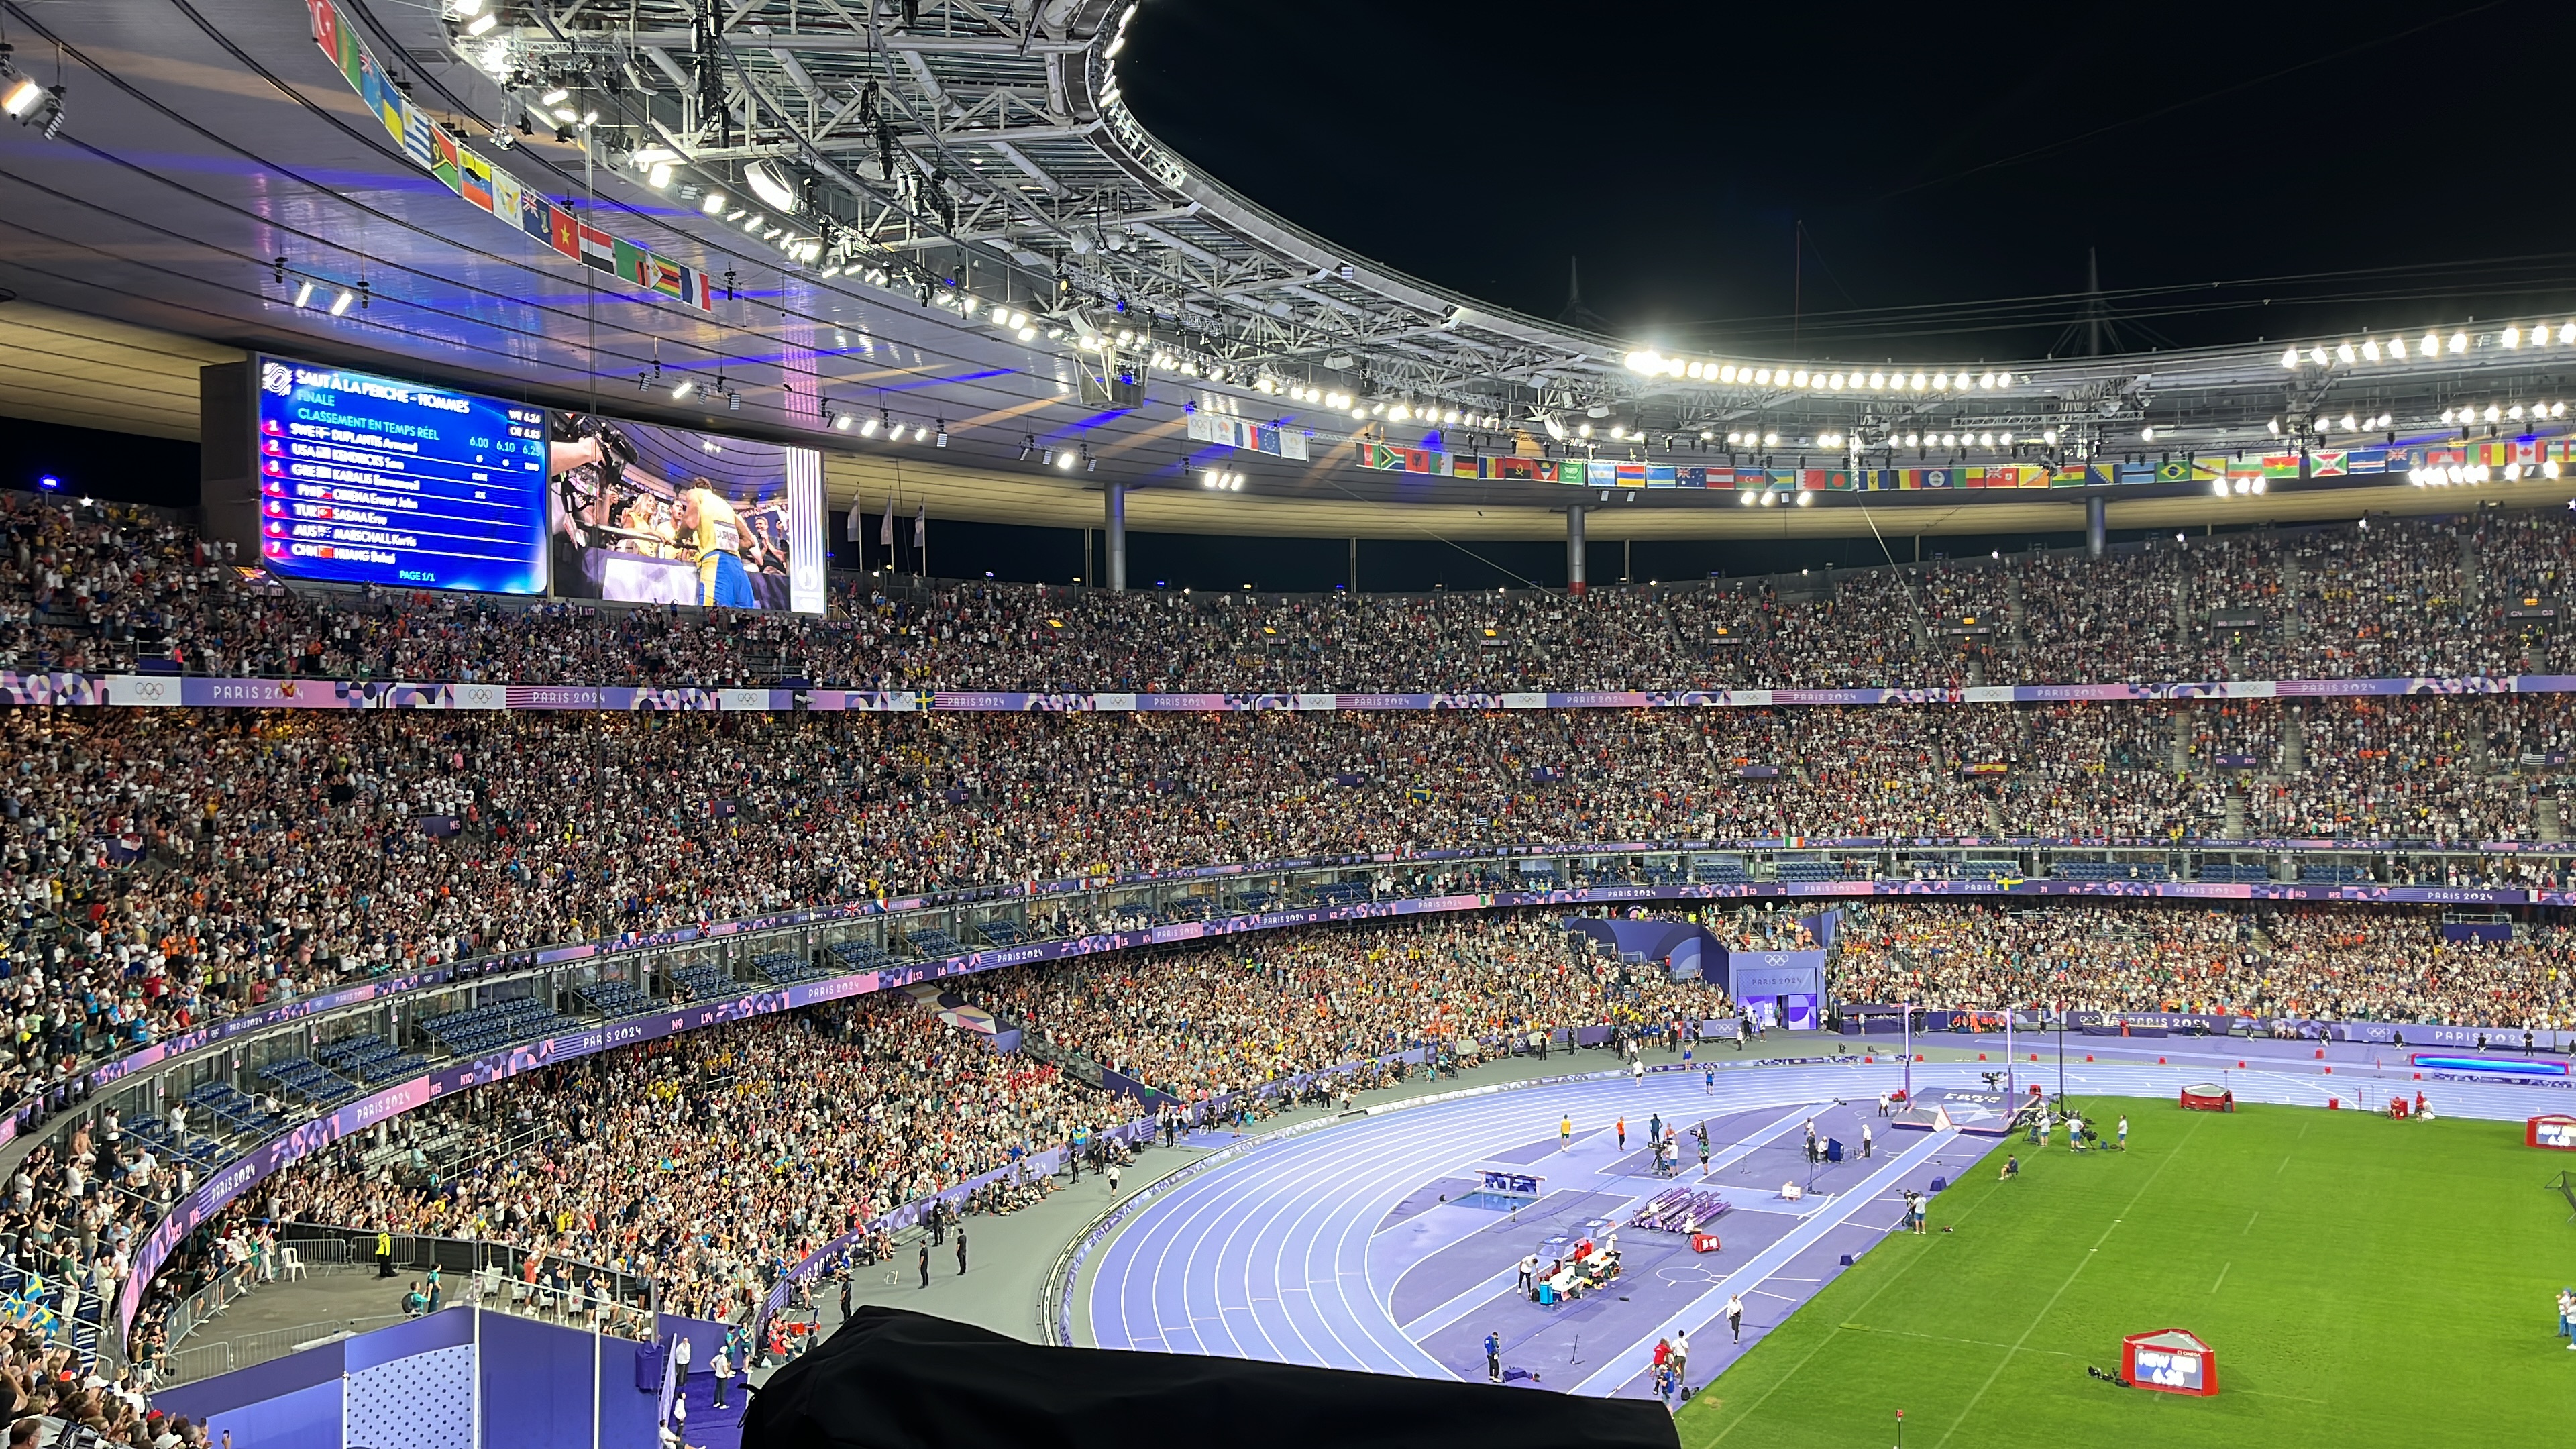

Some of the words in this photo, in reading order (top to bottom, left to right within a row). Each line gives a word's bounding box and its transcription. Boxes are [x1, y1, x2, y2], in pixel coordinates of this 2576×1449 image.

[296, 370, 331, 388] SAUT
[331, 373, 343, 391] À
[343, 378, 362, 394] LA
[362, 382, 409, 402] PERCHE
[418, 393, 470, 414] HOMMES
[296, 389, 335, 406] FINALE
[297, 408, 368, 428] CLASSEMENT
[368, 419, 382, 431] EN
[384, 422, 415, 437] TEMPS
[417, 425, 440, 441] RÉEL
[269, 419, 278, 432] 1
[290, 423, 316, 437] SWE
[331, 429, 382, 447] DUPLANTIS
[269, 439, 278, 452] 2
[292, 443, 316, 457] USA
[470, 436, 489, 449] 6.00
[496, 440, 515, 453] 6.10
[270, 460, 279, 472] 3
[292, 464, 315, 478] GRE
[270, 482, 280, 493] 4
[270, 500, 280, 513] 5
[293, 503, 317, 517] TUR
[333, 509, 368, 523] SASMA
[270, 521, 280, 534] 6
[293, 524, 317, 537] AUS
[271, 541, 281, 553] 7
[292, 544, 318, 557] CHN
[333, 548, 370, 562] HUANG
[399, 569, 421, 580] PAGE
[422, 572, 435, 582] 1/1
[214, 686, 259, 698] PARIS
[265, 686, 303, 699] 204
[2037, 689, 2070, 697] PARIS
[2074, 688, 2104, 696] 2024
[2302, 684, 2338, 692] PARIS
[2342, 683, 2375, 692] 2024
[533, 692, 569, 703] PARIS
[574, 692, 606, 703] 2024
[947, 697, 975, 706] PARIS
[979, 697, 1004, 706] 2024
[1154, 698, 1179, 706] PARIS
[1183, 698, 1206, 706] 2024
[1354, 698, 1381, 706] PARIS
[1385, 697, 1409, 705] 2024
[1566, 696, 1595, 704] PARIS
[1598, 696, 1625, 704] 2024
[1794, 694, 1825, 702] PARIS
[1828, 693, 1856, 701] 2024
[727, 804, 735, 813] N3
[450, 820, 460, 830] N5
[2176, 886, 2205, 894] PARIS
[1263, 916, 1284, 925] PARIS
[1285, 914, 1304, 923] 2024
[1330, 912, 1337, 920] K2
[1157, 928, 1177, 938] PARIS
[1179, 926, 1198, 936] 2024
[1121, 936, 1128, 947] L5
[997, 953, 1020, 963] PARIS
[1022, 949, 1043, 959] 2024
[938, 966, 947, 976] L6
[808, 985, 833, 998] PARIS
[837, 981, 859, 994] 2024
[672, 1018, 684, 1030] N9
[700, 1012, 713, 1024] L14
[584, 1031, 612, 1048] PARS
[614, 1025, 641, 1040] 2024
[2436, 1031, 2479, 1041] PARIS
[461, 1072, 474, 1085] N10
[430, 1082, 442, 1095] N15
[357, 1103, 383, 1121] PARIS
[386, 1091, 410, 1110] 2024
[212, 1177, 232, 1203] PARIS
[233, 1163, 256, 1188] 2024
